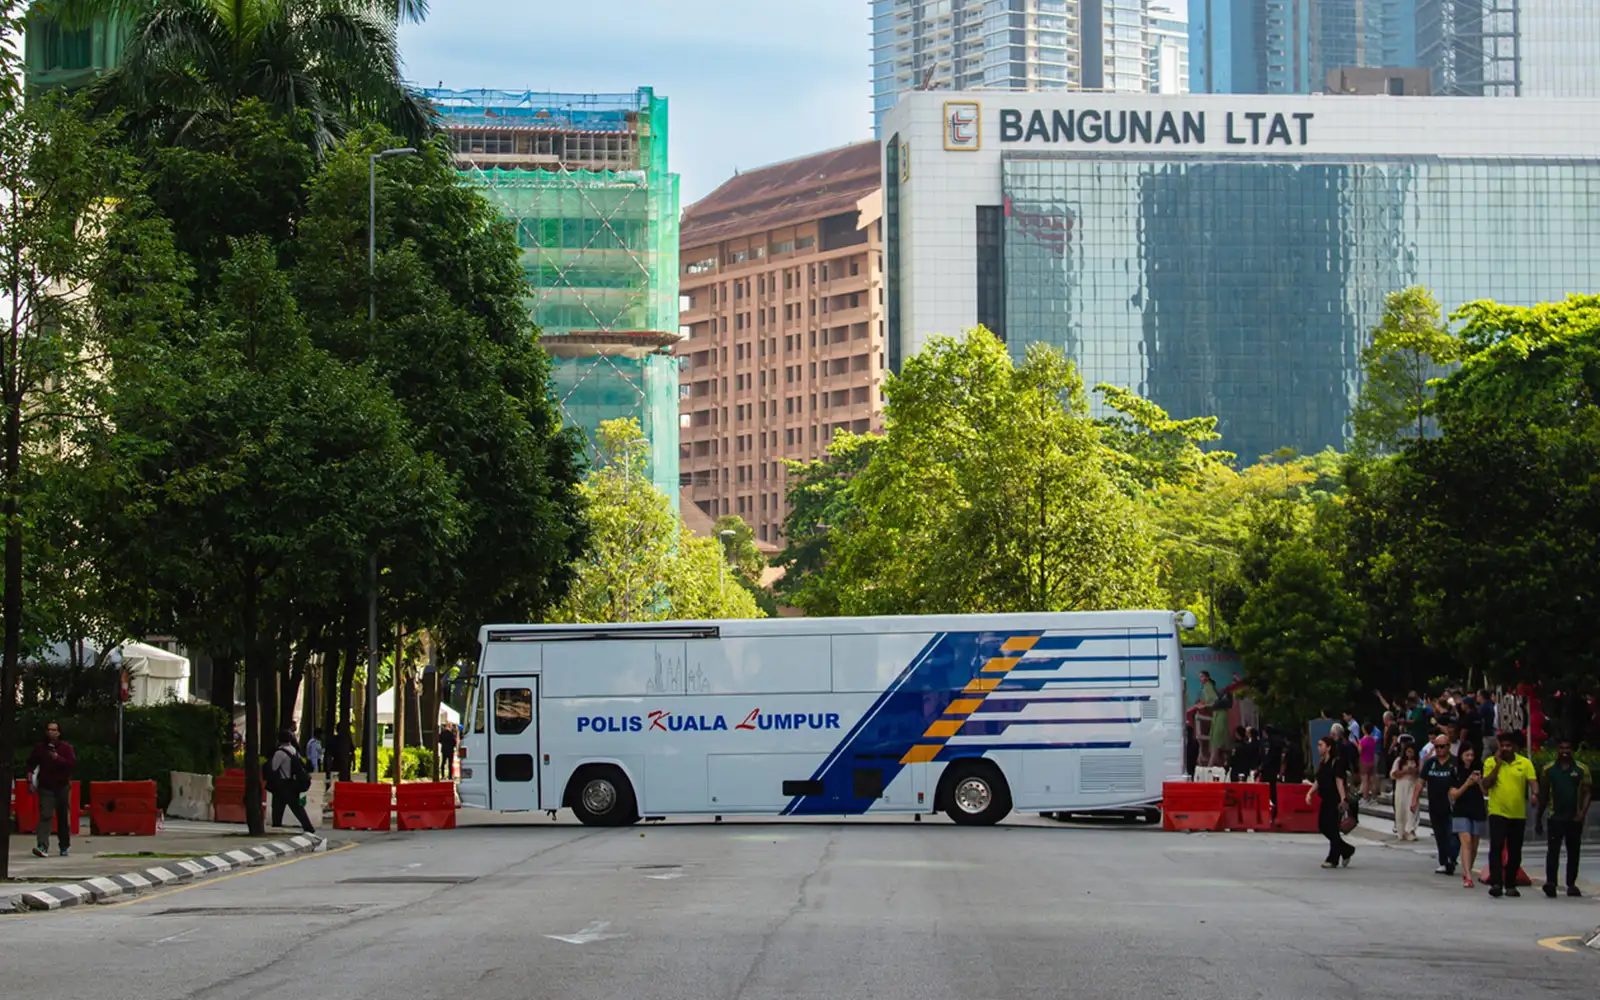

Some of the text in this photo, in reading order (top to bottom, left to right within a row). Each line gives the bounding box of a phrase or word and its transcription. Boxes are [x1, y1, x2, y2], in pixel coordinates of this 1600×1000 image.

[1000, 108, 1314, 145] BANGUNAN LTAT
[577, 708, 840, 732] POLIS KUALA LUMPUR
